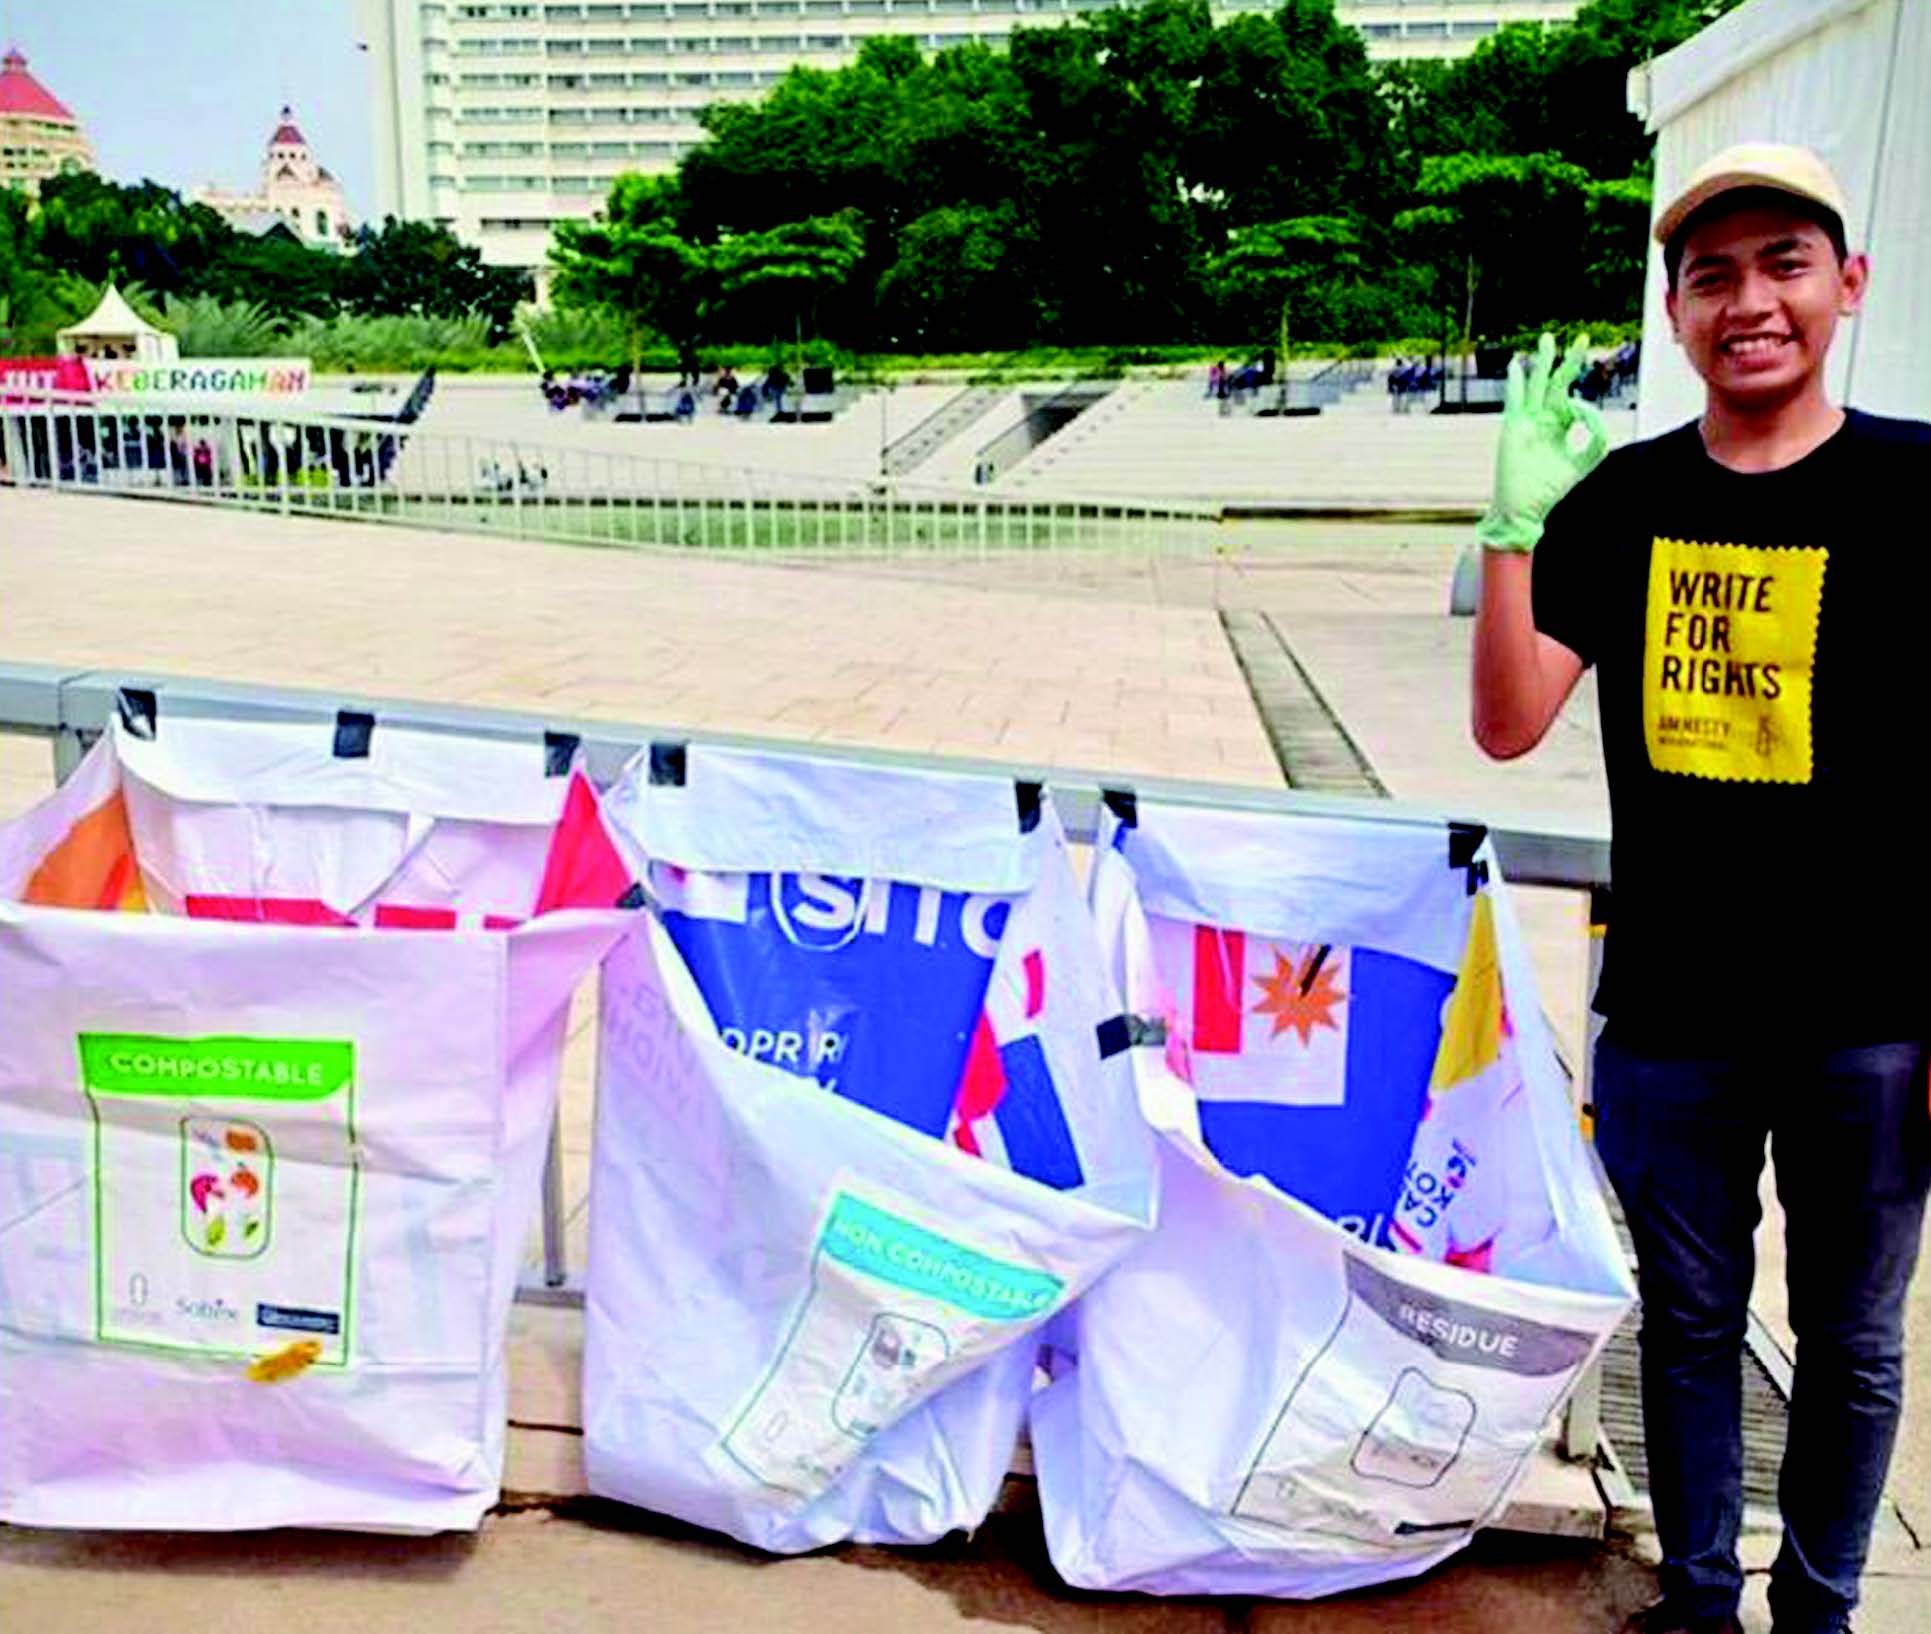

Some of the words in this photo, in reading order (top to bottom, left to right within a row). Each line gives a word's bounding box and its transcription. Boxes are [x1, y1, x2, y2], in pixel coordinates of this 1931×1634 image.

[1669, 570, 1775, 613] WRITE
[1665, 612, 1731, 654] FOR
[1661, 655, 1781, 700] RIGHTS
[109, 1052, 323, 1087] COMPOSTABLE
[1399, 1303, 1520, 1358] RESIDUE
